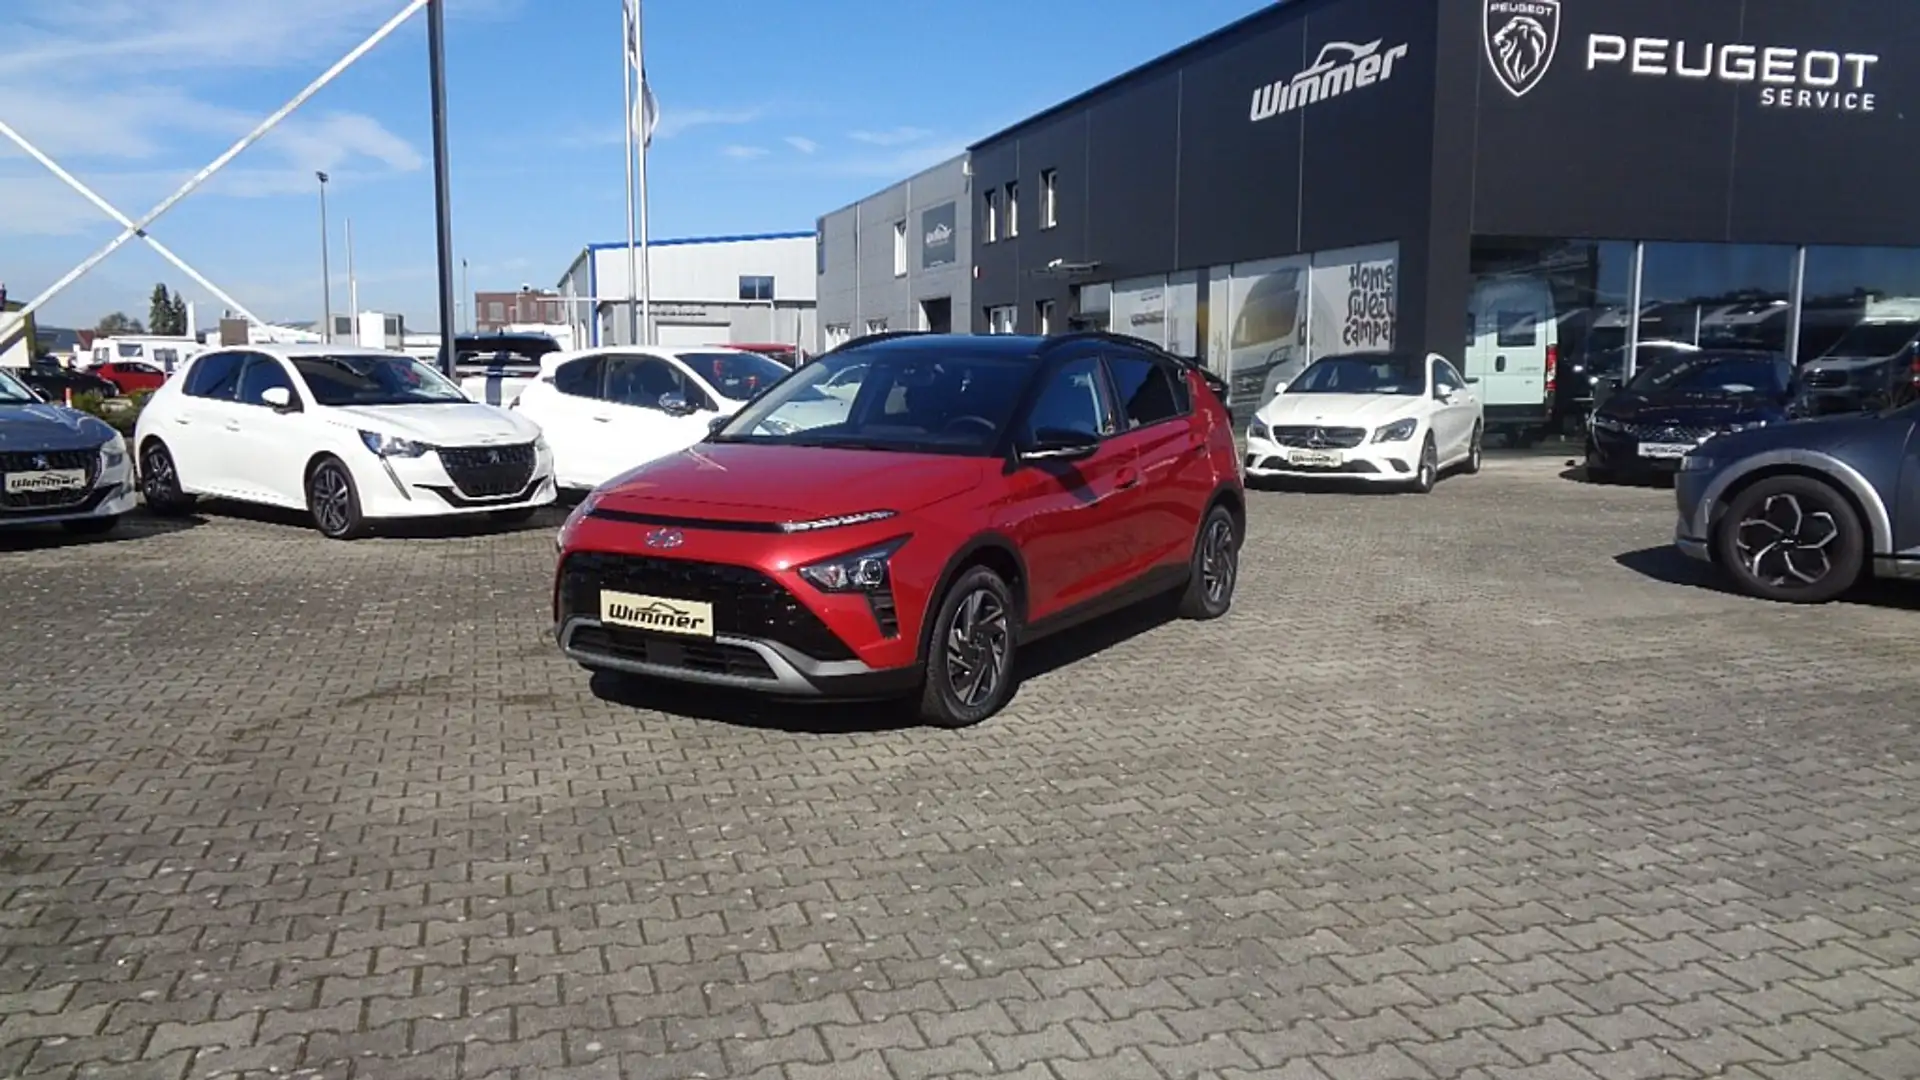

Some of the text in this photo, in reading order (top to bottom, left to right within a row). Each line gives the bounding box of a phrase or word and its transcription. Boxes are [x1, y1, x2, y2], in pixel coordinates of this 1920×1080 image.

[1490, 3, 1553, 16] PEUGEOT
[1587, 33, 1879, 88] PEUGEOT
[1250, 43, 1408, 121] Wimmer
[1761, 87, 1876, 111] SERVICE
[1349, 261, 1394, 292] Home
[609, 603, 705, 629] Wimmer
